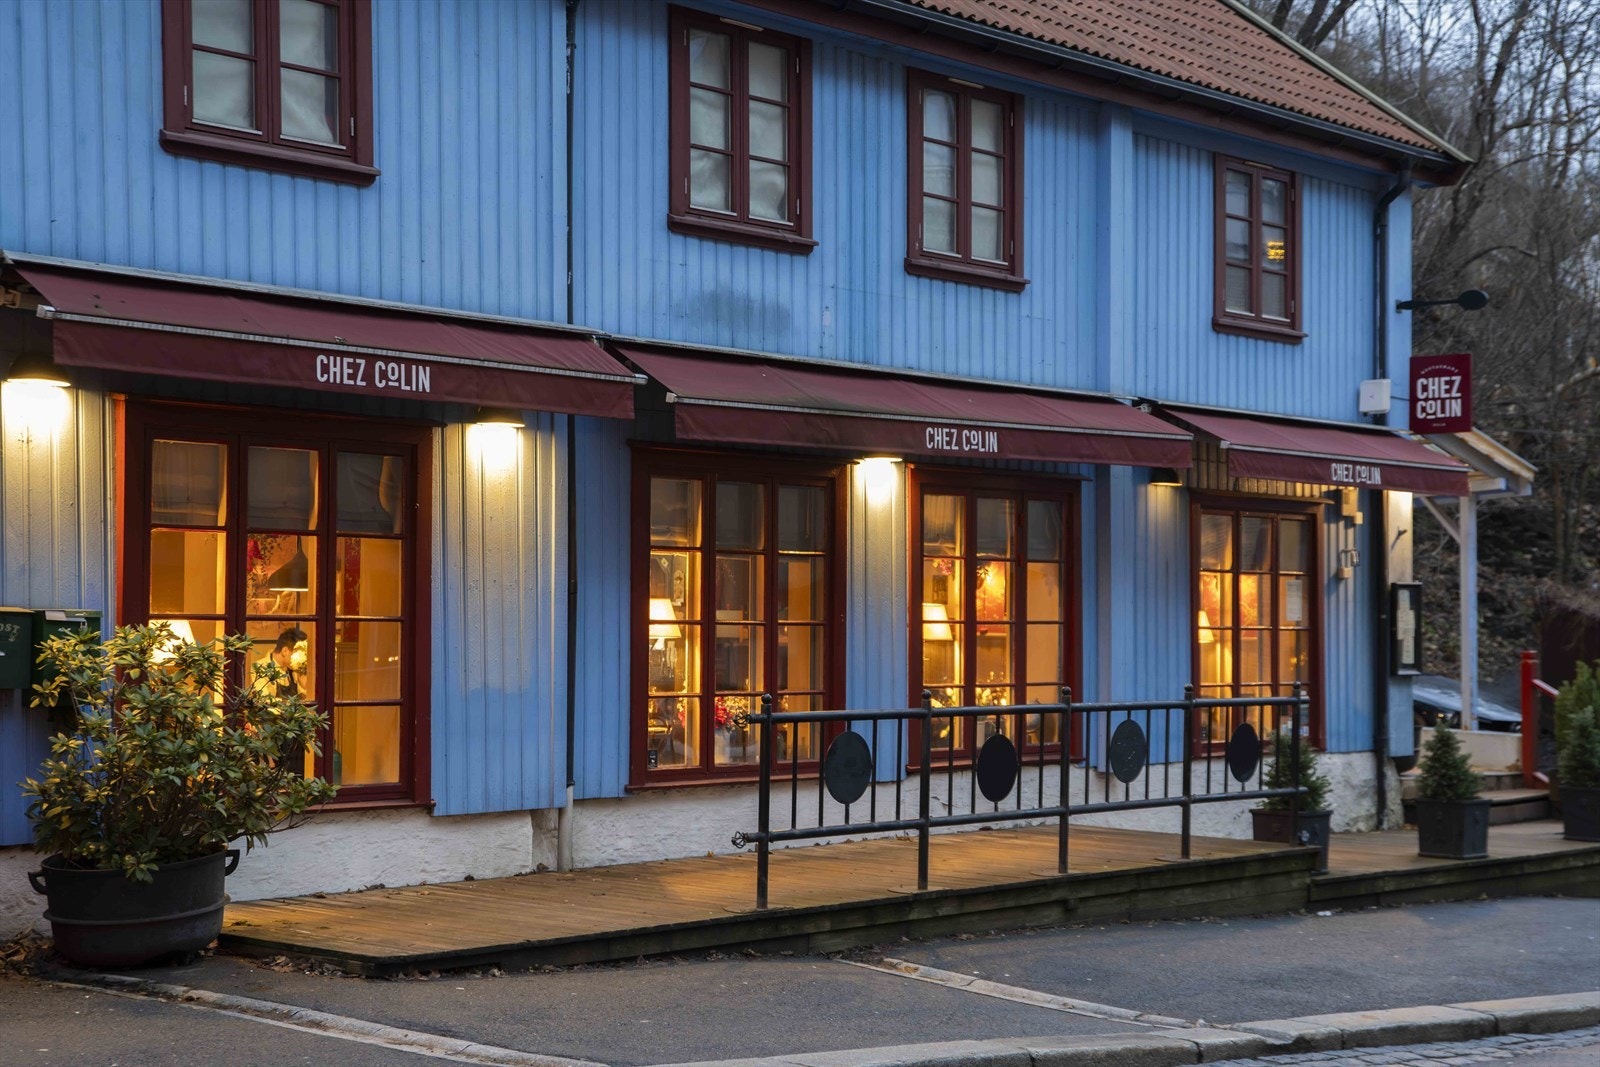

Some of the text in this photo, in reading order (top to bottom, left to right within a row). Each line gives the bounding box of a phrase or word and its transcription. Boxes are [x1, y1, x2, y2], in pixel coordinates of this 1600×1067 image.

[316, 354, 367, 387] CHEZ
[1416, 375, 1462, 400] CHEZ
[926, 426, 959, 450] CHEZ
[1331, 462, 1354, 482] CHEZ
